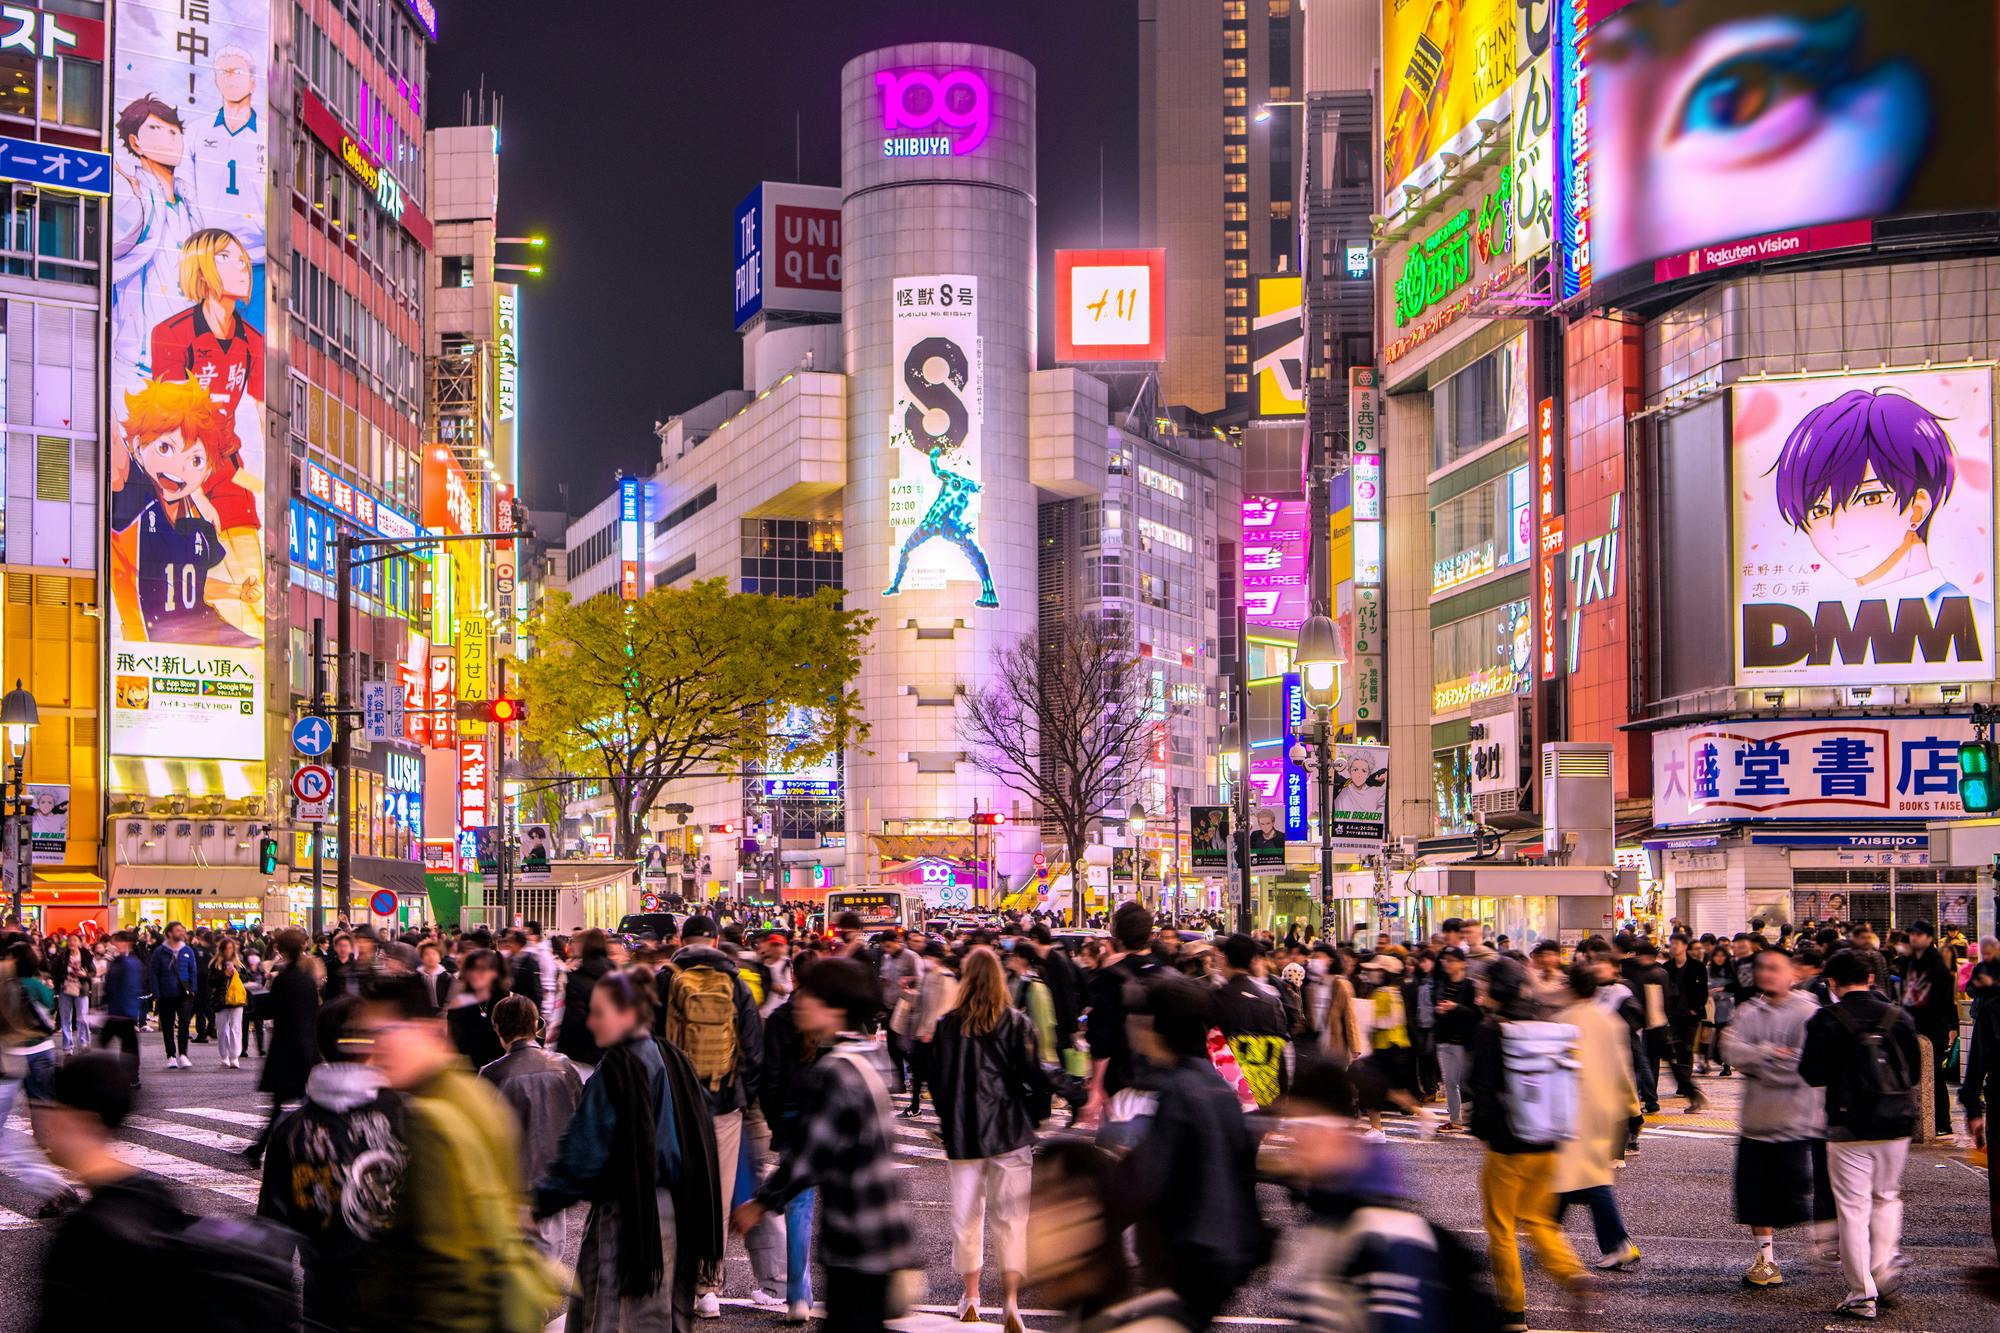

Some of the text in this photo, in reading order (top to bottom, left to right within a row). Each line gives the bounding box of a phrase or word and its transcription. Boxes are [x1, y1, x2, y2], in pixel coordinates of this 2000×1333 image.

[875, 70, 991, 156] 109
[884, 137, 950, 156] SHIBUYA
[226, 159, 239, 195] 1
[377, 167, 404, 221] ガスト
[741, 207, 755, 260] THE
[785, 216, 839, 248] UNI
[785, 250, 842, 284] QLO
[1706, 236, 1799, 266] Rakuten Vision
[736, 251, 760, 312] PRIME
[1352, 269, 1364, 278] 7F
[897, 284, 974, 307] 怪獣8号
[499, 295, 513, 422] BIC CAMERA
[1358, 391, 1374, 440] 渋谷西村
[624, 484, 634, 497] THE
[891, 485, 912, 495] 4/13
[890, 518, 915, 526] ON AIR
[891, 501, 915, 512] 23:00
[1269, 531, 1300, 541] FREE
[1270, 575, 1300, 585] FREE
[1570, 530, 1617, 608] クスリ
[164, 563, 196, 612] 10
[1752, 581, 1809, 598] 恋の病
[1358, 607, 1367, 639] パーラー
[1369, 602, 1377, 635] フルーツ
[1743, 596, 1983, 668] DMM
[116, 653, 254, 679] 飛べ！新しい頂へ。
[166, 681, 179, 689] App
[216, 682, 252, 693] Google Play
[374, 686, 384, 737] 渋谷駅前
[387, 752, 420, 793] LUSH
[1662, 737, 1961, 800] 大盛堂書店
[1289, 773, 1301, 828] みずほ銀行
[1899, 801, 1964, 811] BOOKS TAISE
[1849, 837, 1917, 845] TAISEIDO
[921, 864, 951, 886] 109
